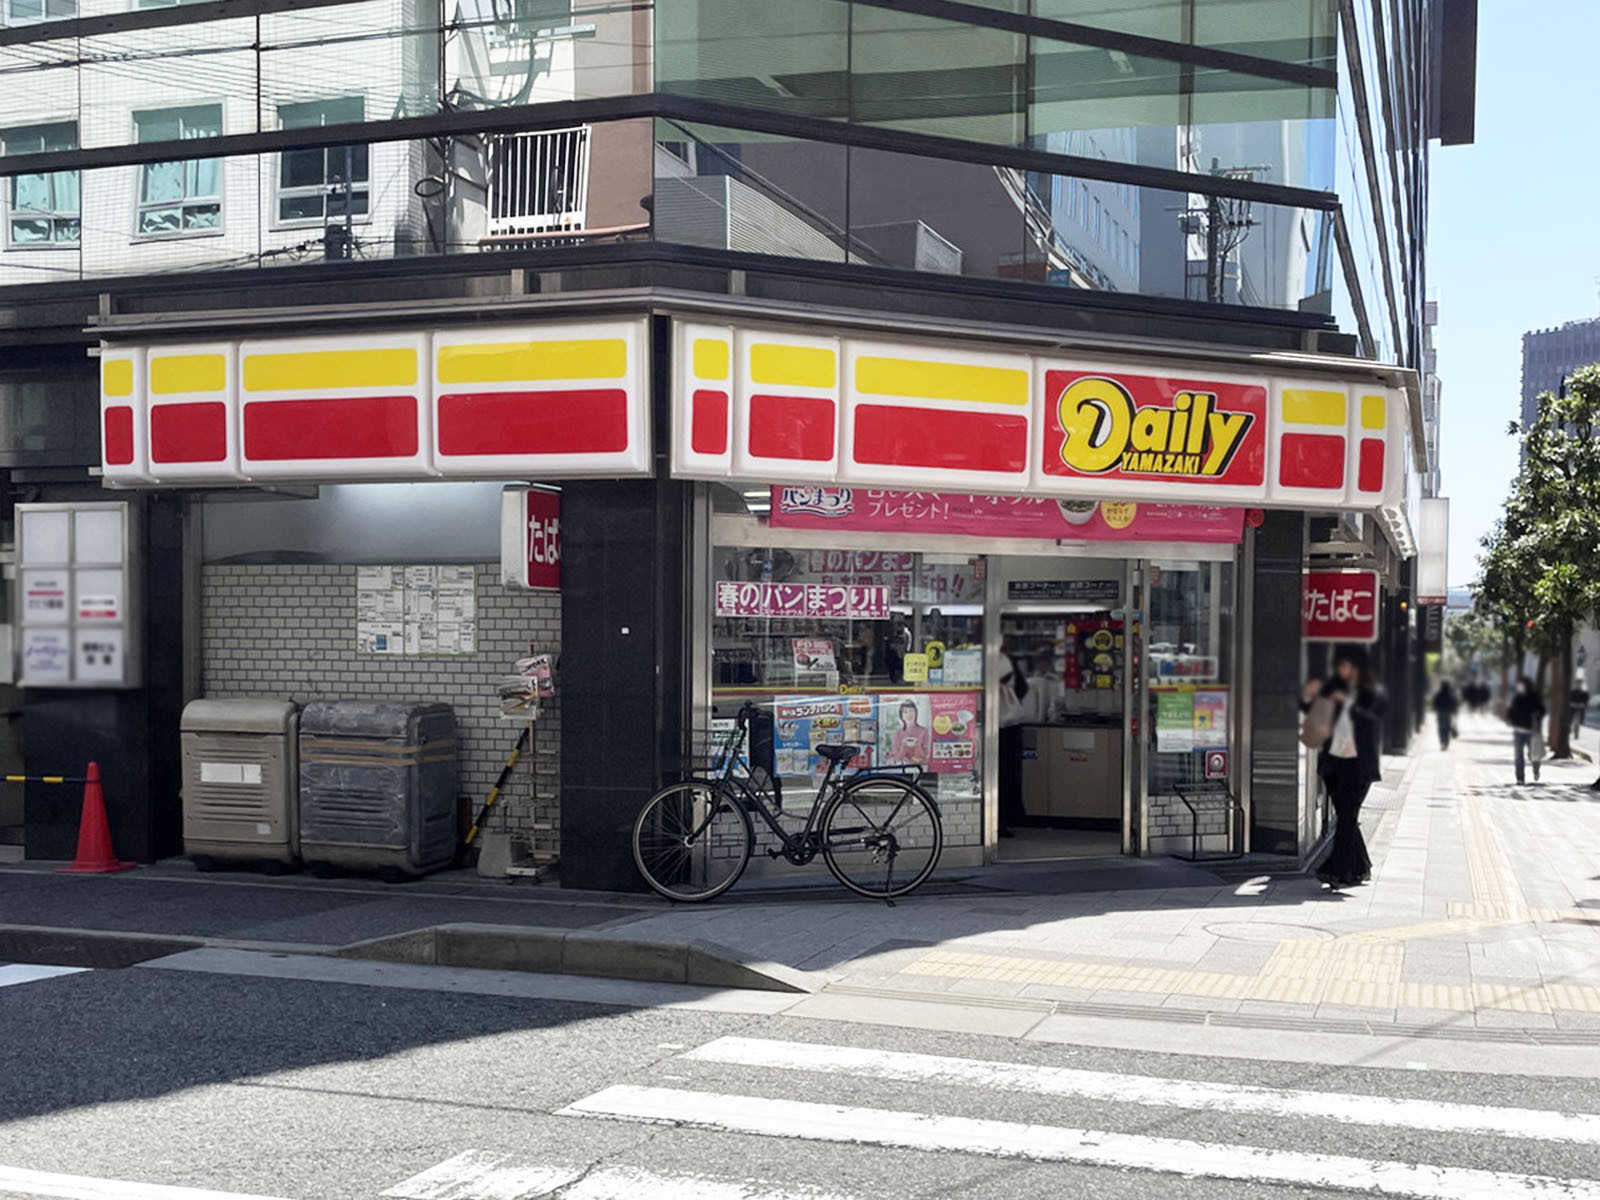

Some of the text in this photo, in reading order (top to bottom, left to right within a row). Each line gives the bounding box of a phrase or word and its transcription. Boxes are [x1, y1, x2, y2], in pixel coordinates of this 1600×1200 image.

[1059, 377, 1253, 475] Daily
[1121, 451, 1200, 474] YAMAZAKI
[1308, 589, 1372, 622] たばこ
